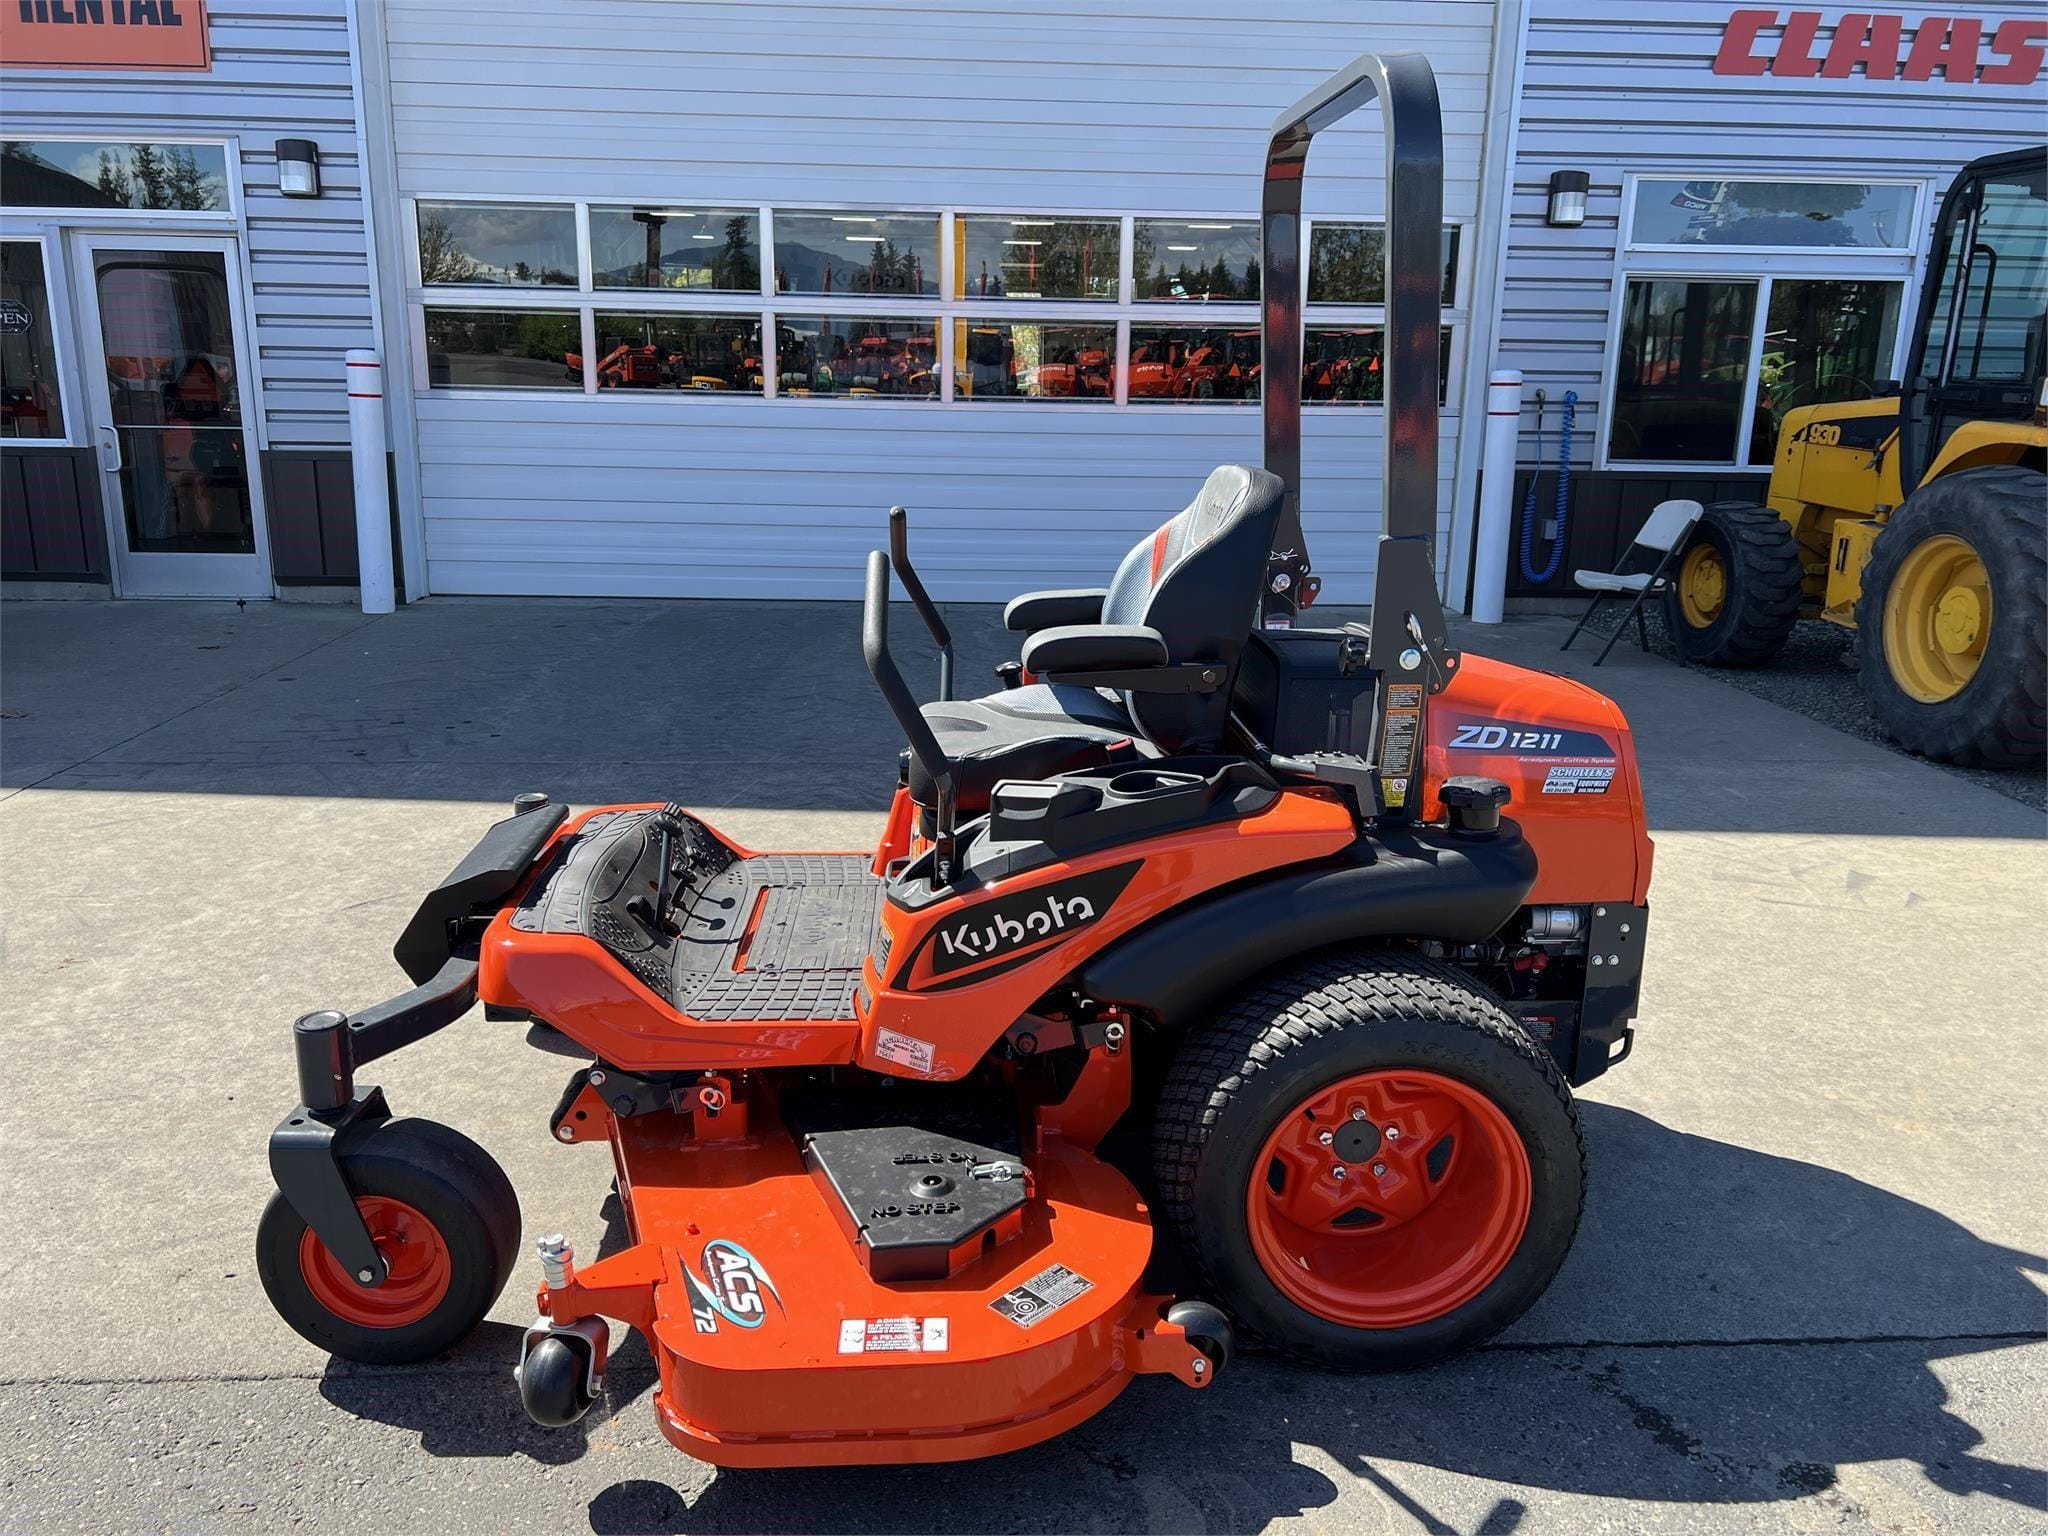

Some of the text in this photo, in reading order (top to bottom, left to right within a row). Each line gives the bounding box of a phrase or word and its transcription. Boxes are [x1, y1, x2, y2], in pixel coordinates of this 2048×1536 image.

[1712, 9, 2048, 86] CLAAS
[1809, 424, 1841, 446] 930
[1449, 725, 1562, 750] ZD 1211
[941, 896, 1095, 957] Kubota
[871, 1202, 960, 1219] NO STEP
[715, 1250, 764, 1313] ACS
[692, 1307, 718, 1333] 72
